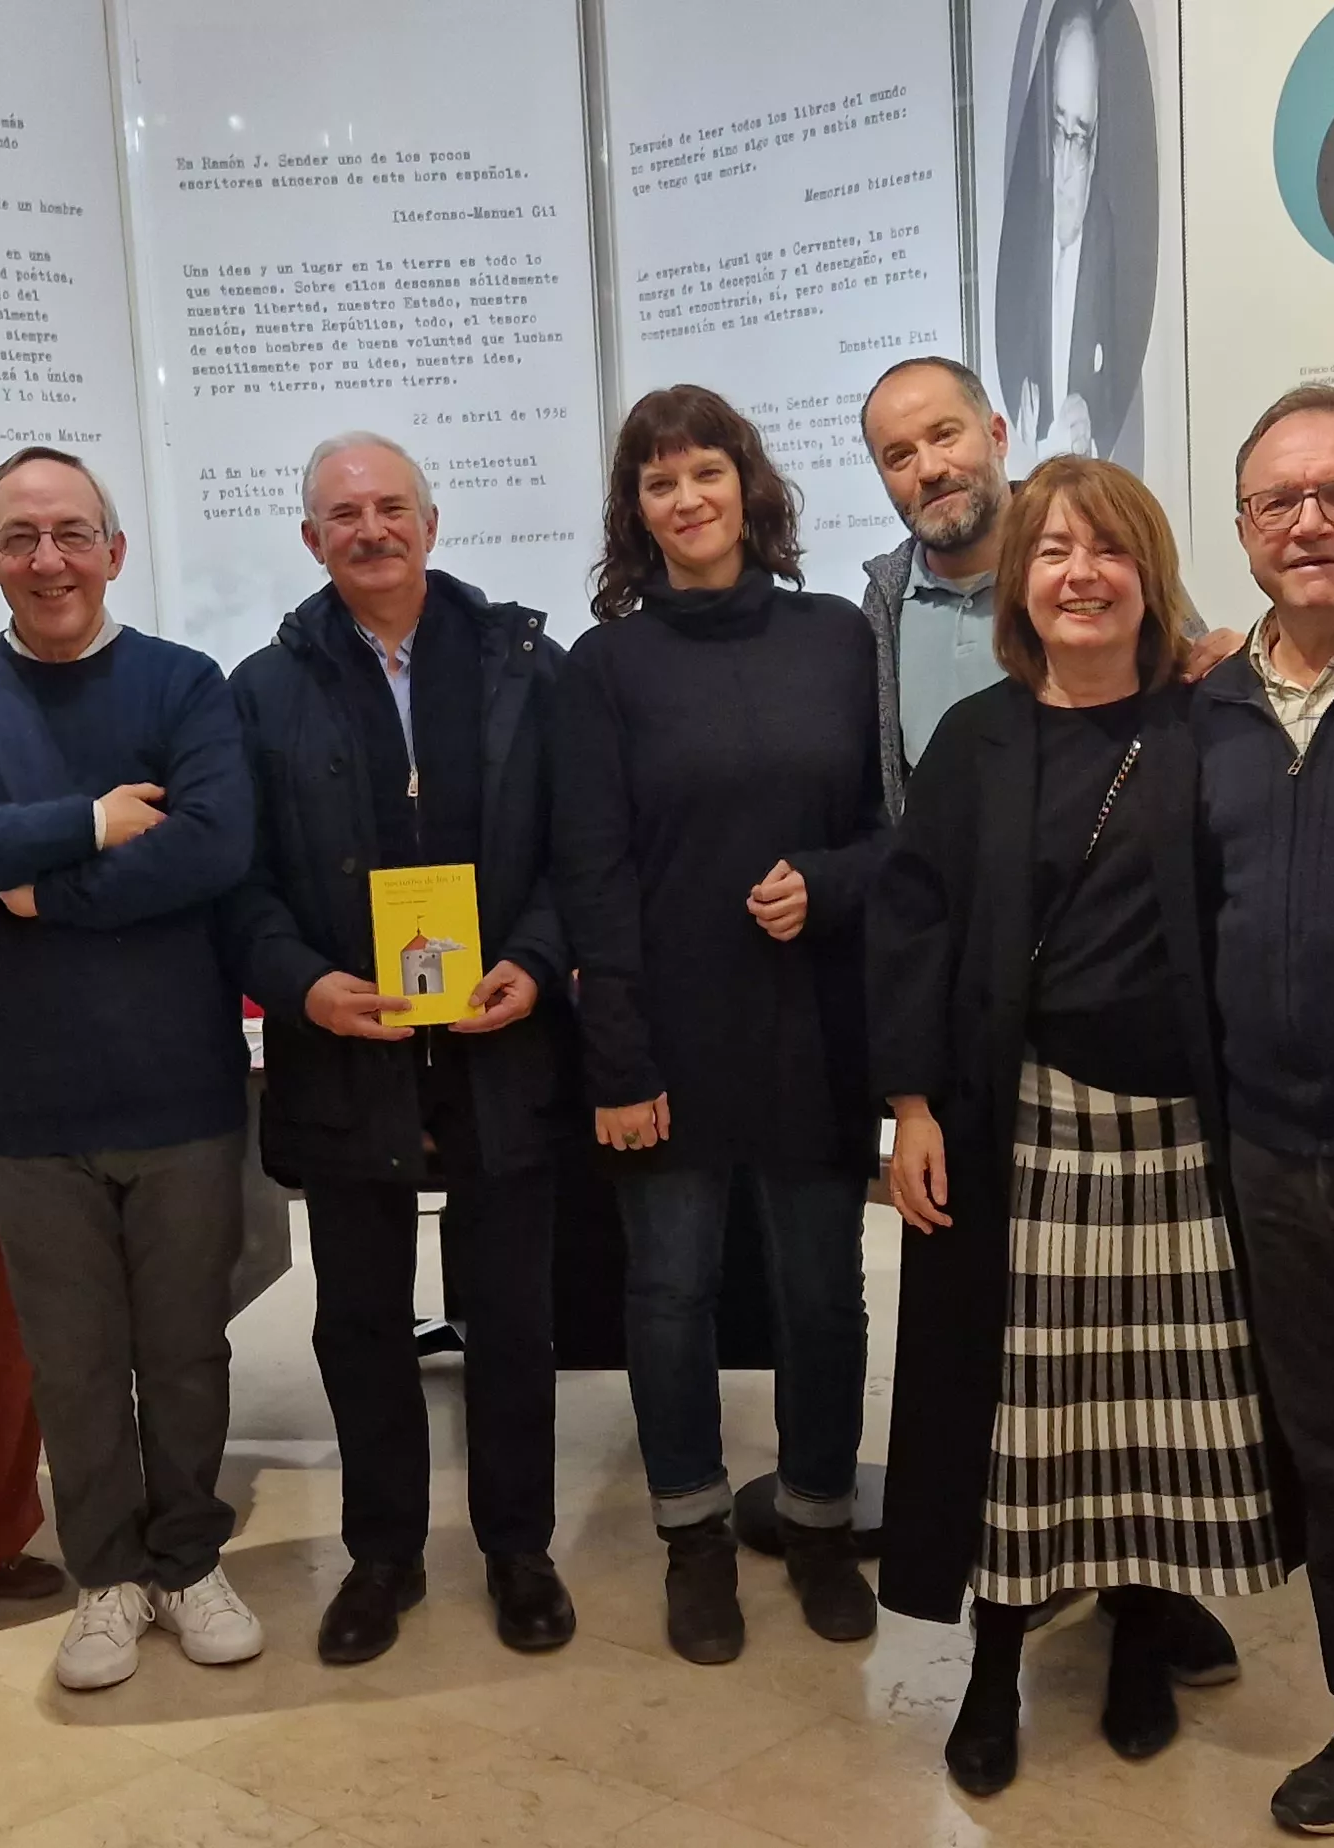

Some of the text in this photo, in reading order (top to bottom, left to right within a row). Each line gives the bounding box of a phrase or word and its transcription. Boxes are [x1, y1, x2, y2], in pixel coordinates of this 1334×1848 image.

[628, 84, 906, 155] Después de leer todos los libros del mundo
[178, 167, 528, 190] escritores sinceros de esta hora española.
[632, 162, 756, 197] que tengo que morir.
[804, 182, 859, 202] Memorias
[17, 201, 32, 212] un
[39, 199, 83, 216] hombre
[392, 204, 556, 223] Ildefonso-Manuel Gil
[5, 249, 22, 260] en
[28, 251, 51, 262] una
[182, 253, 541, 278] Una idea y un lugar en la tierra es todo lo
[15, 266, 73, 285] poética,
[838, 328, 937, 354] Donatella Pini
[58, 428, 102, 442] Mainer
[813, 513, 895, 531] José Domingo
